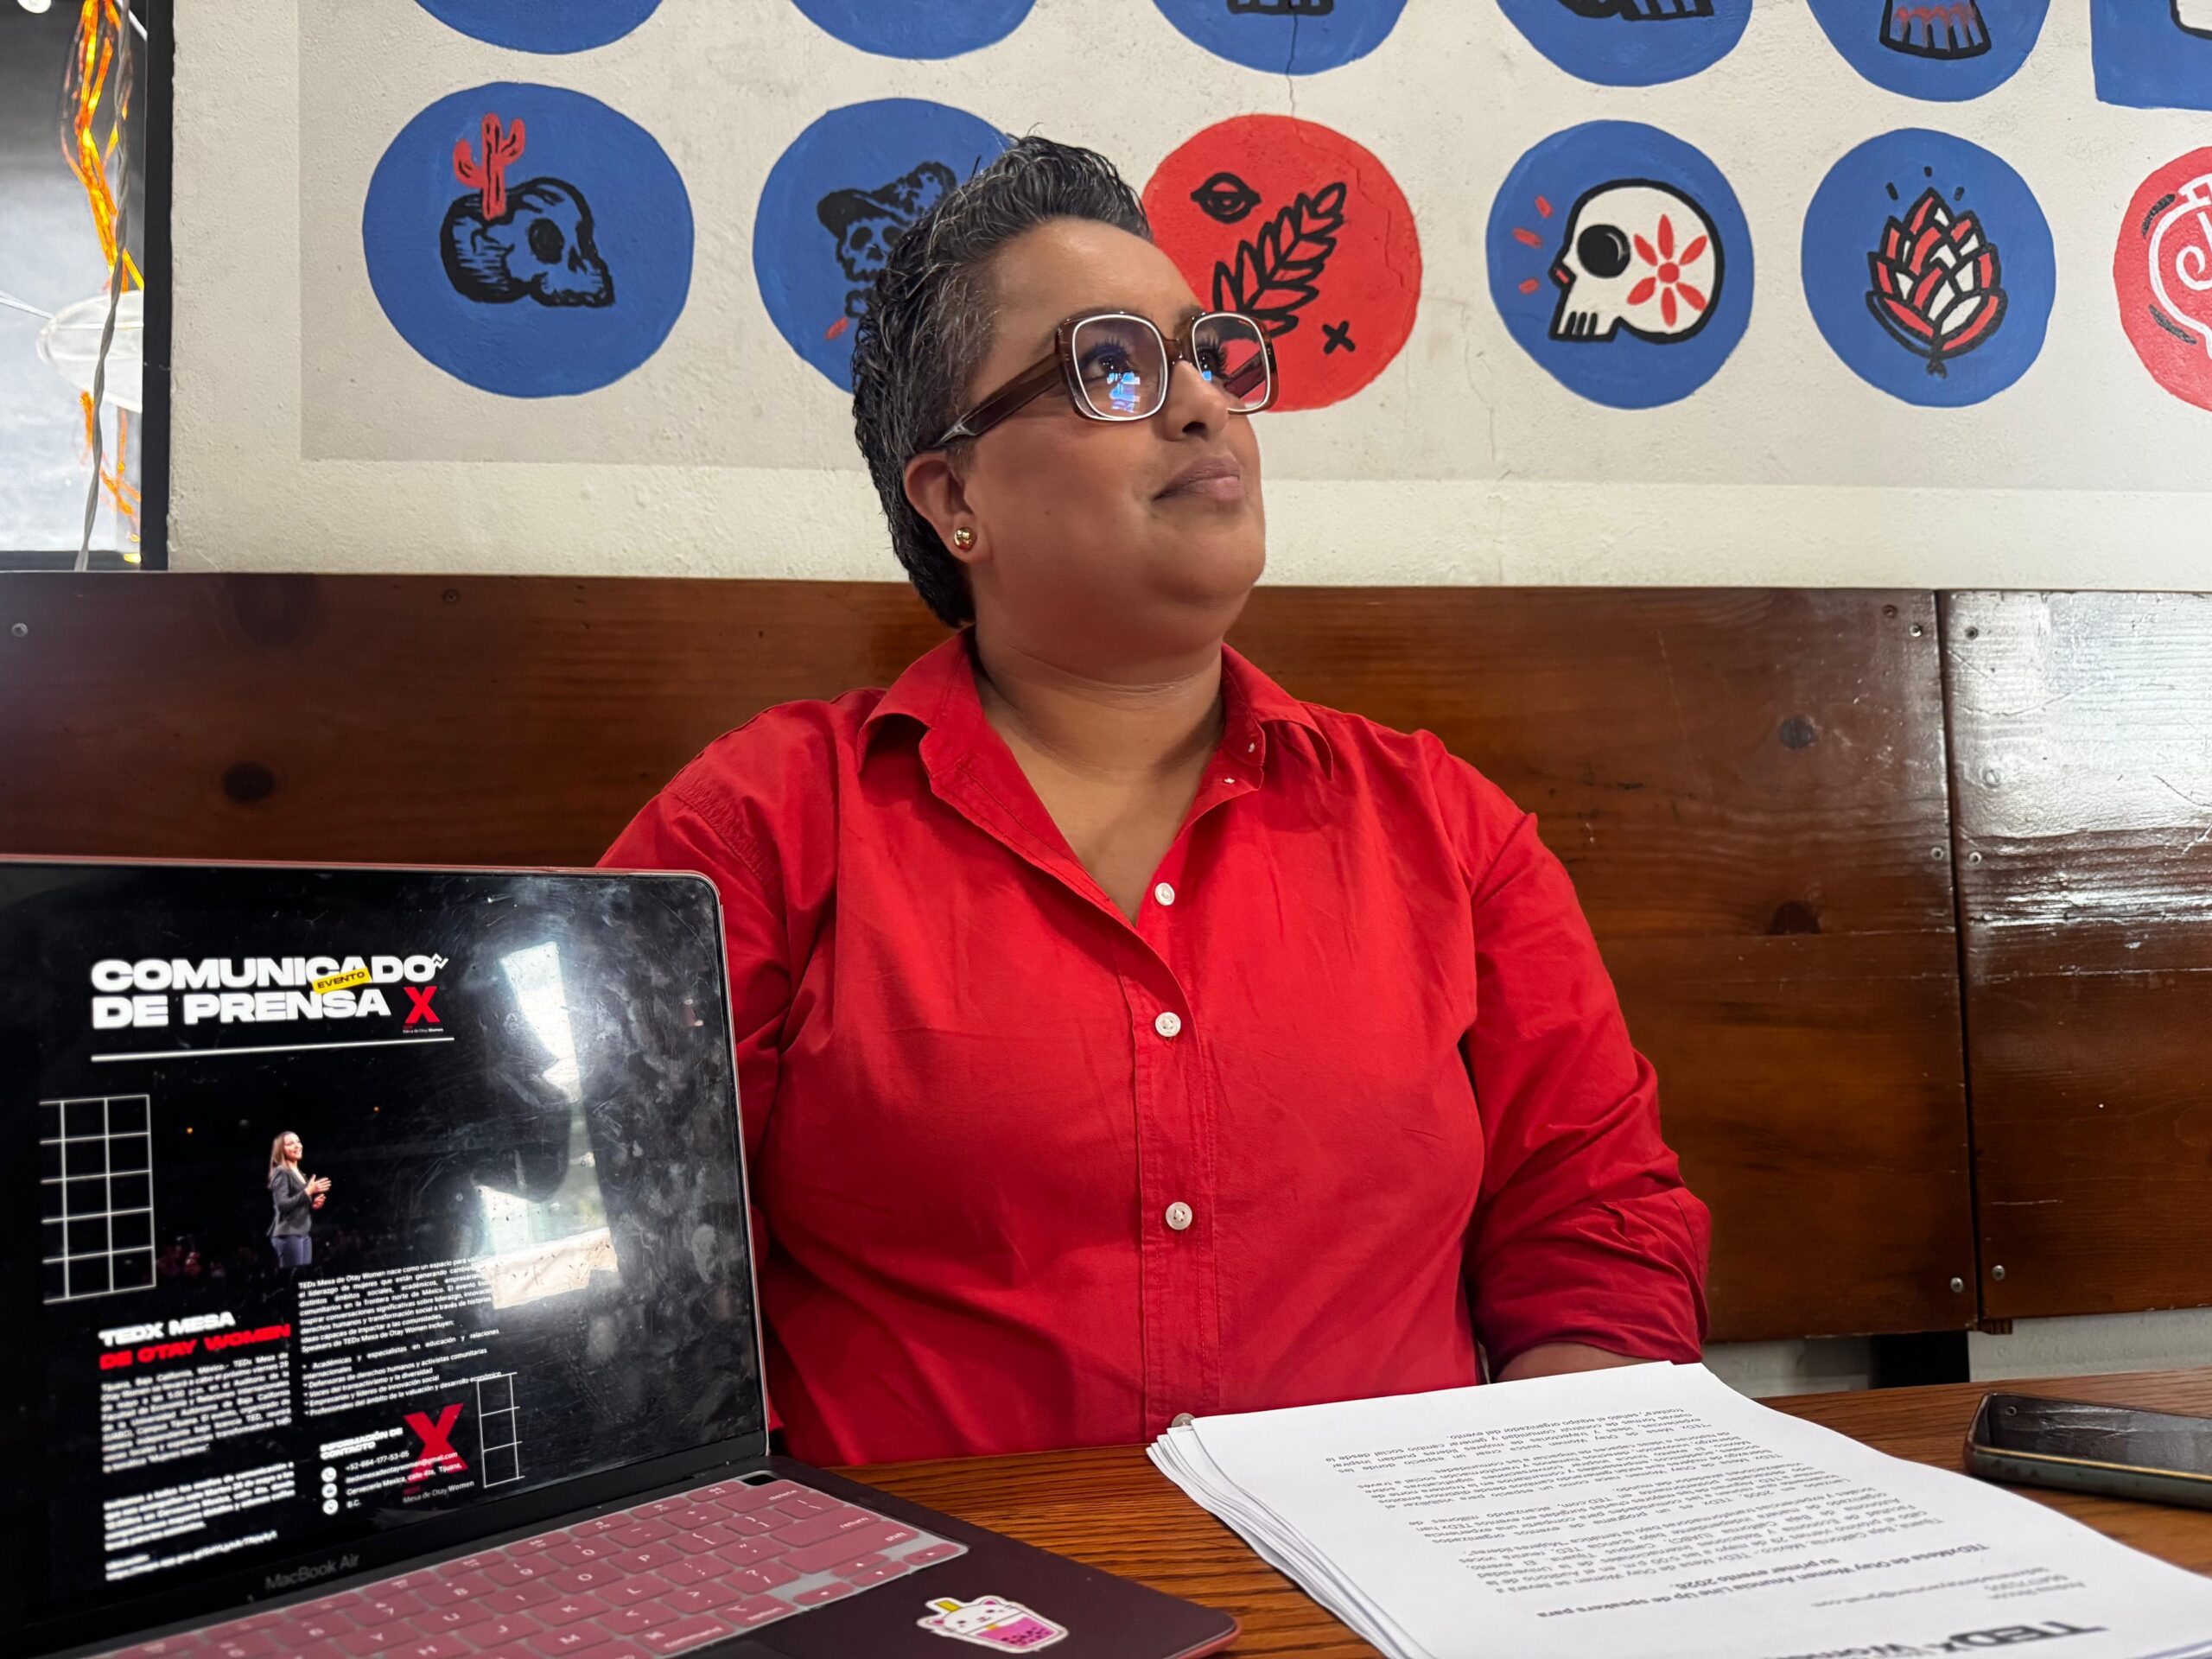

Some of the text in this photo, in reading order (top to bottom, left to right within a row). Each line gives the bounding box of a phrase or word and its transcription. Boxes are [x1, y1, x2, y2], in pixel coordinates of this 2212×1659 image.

[91, 955, 436, 992] COMUNICADO
[318, 971, 365, 990] EVENTO
[92, 988, 391, 1029] DE PRENSA
[404, 986, 441, 1023] X
[298, 1281, 315, 1289] TEDx
[317, 1277, 335, 1286] Mesa
[346, 1274, 360, 1283] Otay
[362, 1269, 385, 1279] Women
[429, 1259, 452, 1269] espacio
[308, 1286, 338, 1298] liderazgo
[353, 1280, 378, 1291] mujeres
[415, 1268, 447, 1281] generando
[299, 1279, 438, 1307] distintos ámbitos sociales, académicos,
[299, 1303, 340, 1316] comunitarios
[364, 1295, 389, 1306] frontera
[391, 1292, 408, 1300] norte
[422, 1286, 444, 1295] México.
[455, 1281, 475, 1290] evento
[299, 1315, 325, 1326] inspirar
[326, 1306, 374, 1321] conversaciones
[376, 1300, 415, 1313] significativas
[416, 1296, 433, 1306] sobre
[435, 1292, 462, 1303] liderazgo,
[98, 1311, 236, 1347] TEDX MESA
[300, 1323, 331, 1334] derechos
[333, 1318, 361, 1329] humanos
[368, 1308, 414, 1323] transformación
[415, 1306, 432, 1314] social
[439, 1301, 457, 1310] través
[467, 1295, 491, 1305] historias
[320, 1330, 346, 1341] capaces
[402, 1313, 442, 1325] comunidades.
[99, 1324, 291, 1370] DE OTAY WOMEN
[301, 1340, 332, 1353] Speakers
[343, 1336, 360, 1344] TEDx
[361, 1332, 378, 1341] Mesa
[389, 1327, 404, 1338] Otay
[404, 1324, 427, 1333] Women
[312, 1355, 352, 1369] Académicas
[366, 1344, 406, 1359] especialistas
[425, 1336, 455, 1347] educación
[469, 1327, 499, 1338] relaciones
[308, 1375, 345, 1389] Defensoras
[357, 1367, 385, 1379] derechos
[387, 1361, 415, 1373] humanos
[421, 1355, 448, 1366] activistas
[450, 1347, 486, 1360] comunitarias
[308, 1387, 329, 1397] Voces
[342, 1376, 388, 1391] transactivismo
[401, 1367, 432, 1379] diversidad
[309, 1392, 349, 1408] Empresarias
[356, 1387, 377, 1397] líderes
[388, 1378, 420, 1390] innovación
[422, 1374, 439, 1383] social
[309, 1401, 353, 1416] Profesionales
[354, 1398, 365, 1407] del
[365, 1394, 387, 1404] ámbito
[404, 1384, 434, 1395] valuación
[440, 1376, 468, 1389] desarrollo
[469, 1370, 501, 1382] económico
[389, 1427, 404, 1437] DE
[404, 1403, 468, 1484] X
[320, 1441, 376, 1460] CONTACTO
[346, 1482, 382, 1497] Cervecería
[408, 1471, 423, 1481] calle
[403, 1494, 421, 1504] Mesa
[432, 1488, 448, 1499] Otay
[448, 1480, 474, 1492] Women
[768, 1488, 798, 1502] delete
[839, 1516, 869, 1529] return
[884, 1531, 907, 1542] shift
[264, 1554, 359, 1591] MacBook Air
